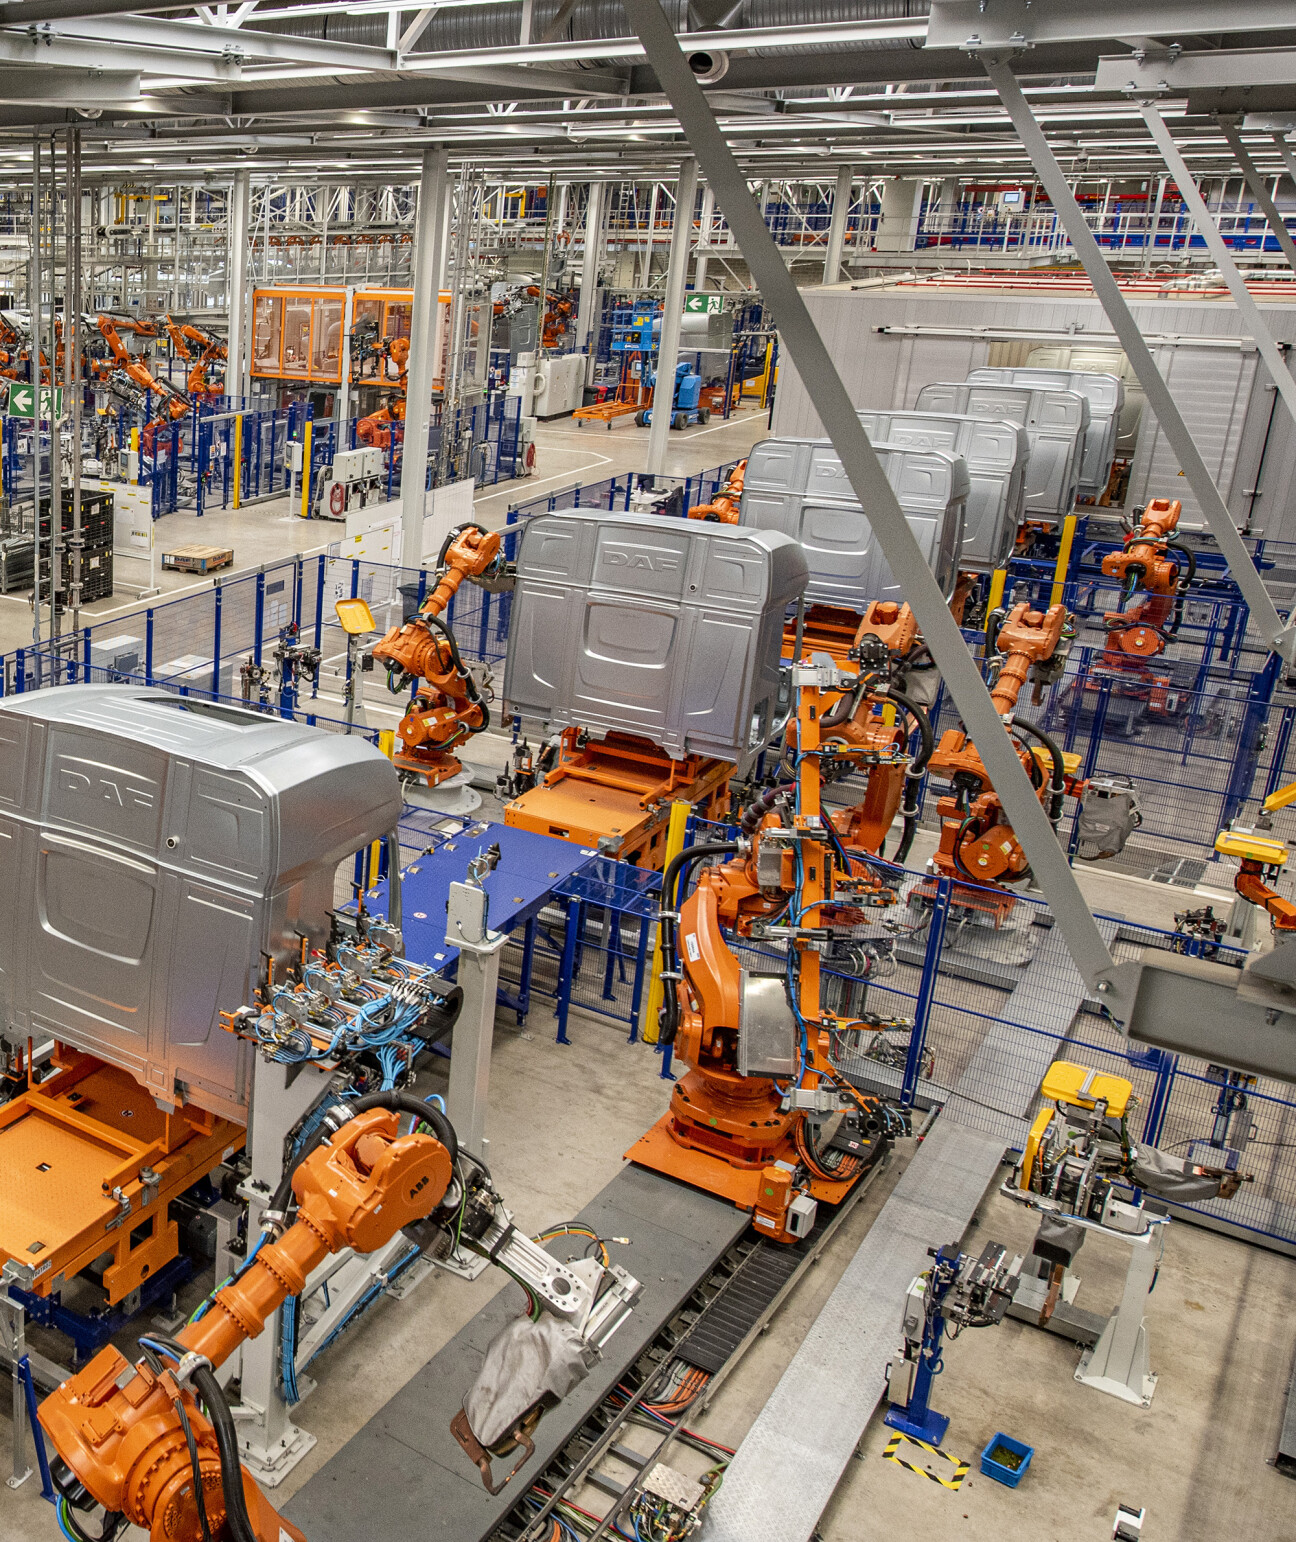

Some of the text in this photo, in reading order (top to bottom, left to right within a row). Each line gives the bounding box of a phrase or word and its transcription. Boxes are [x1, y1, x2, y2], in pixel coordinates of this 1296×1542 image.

[1072, 362, 1115, 371] DAF
[972, 403, 1023, 414] DAF
[894, 434, 951, 447] DAF
[603, 550, 680, 572] DAF
[58, 769, 154, 812] DAF
[410, 1176, 429, 1199] ABB
